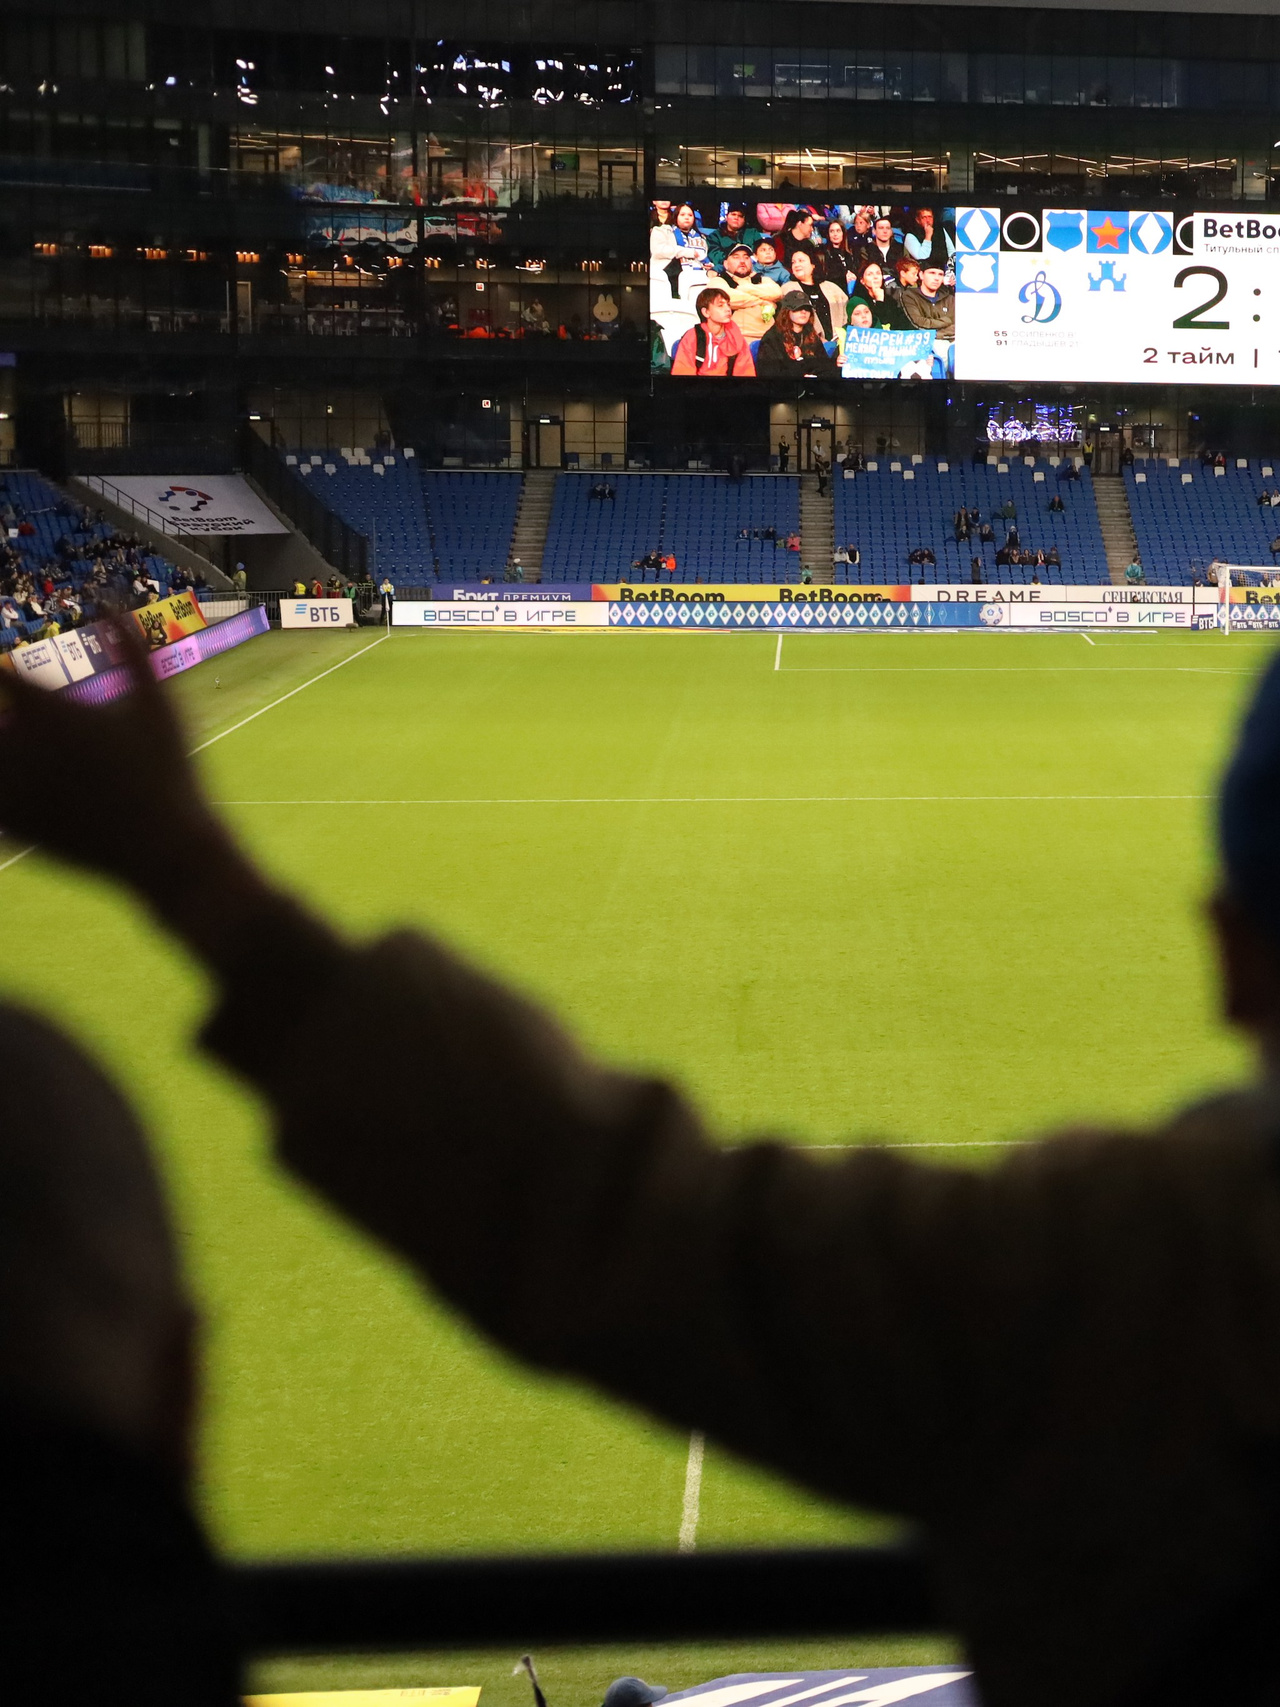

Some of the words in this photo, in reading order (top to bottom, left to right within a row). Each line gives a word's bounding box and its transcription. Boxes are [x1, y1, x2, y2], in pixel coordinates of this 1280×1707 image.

[1203, 243, 1263, 256] Титульный
[848, 328, 904, 346] АНДРЕЙ
[1143, 347, 1158, 363] 2
[1167, 347, 1235, 364] тайм
[503, 593, 571, 602] ПРЕМИУМ
[620, 588, 725, 602] BetBoom
[779, 588, 883, 602] BetBoom
[937, 590, 1041, 602] DREAME
[1102, 590, 1184, 603] СЕНЕЖСКАЯ
[310, 606, 340, 622] ВТБ
[424, 610, 495, 622] BOSCO
[526, 610, 576, 622] ИГРЕ
[1040, 611, 1108, 622] BOSCO
[1138, 611, 1186, 623] ИГРЕ
[1199, 616, 1214, 630] ВТБ
